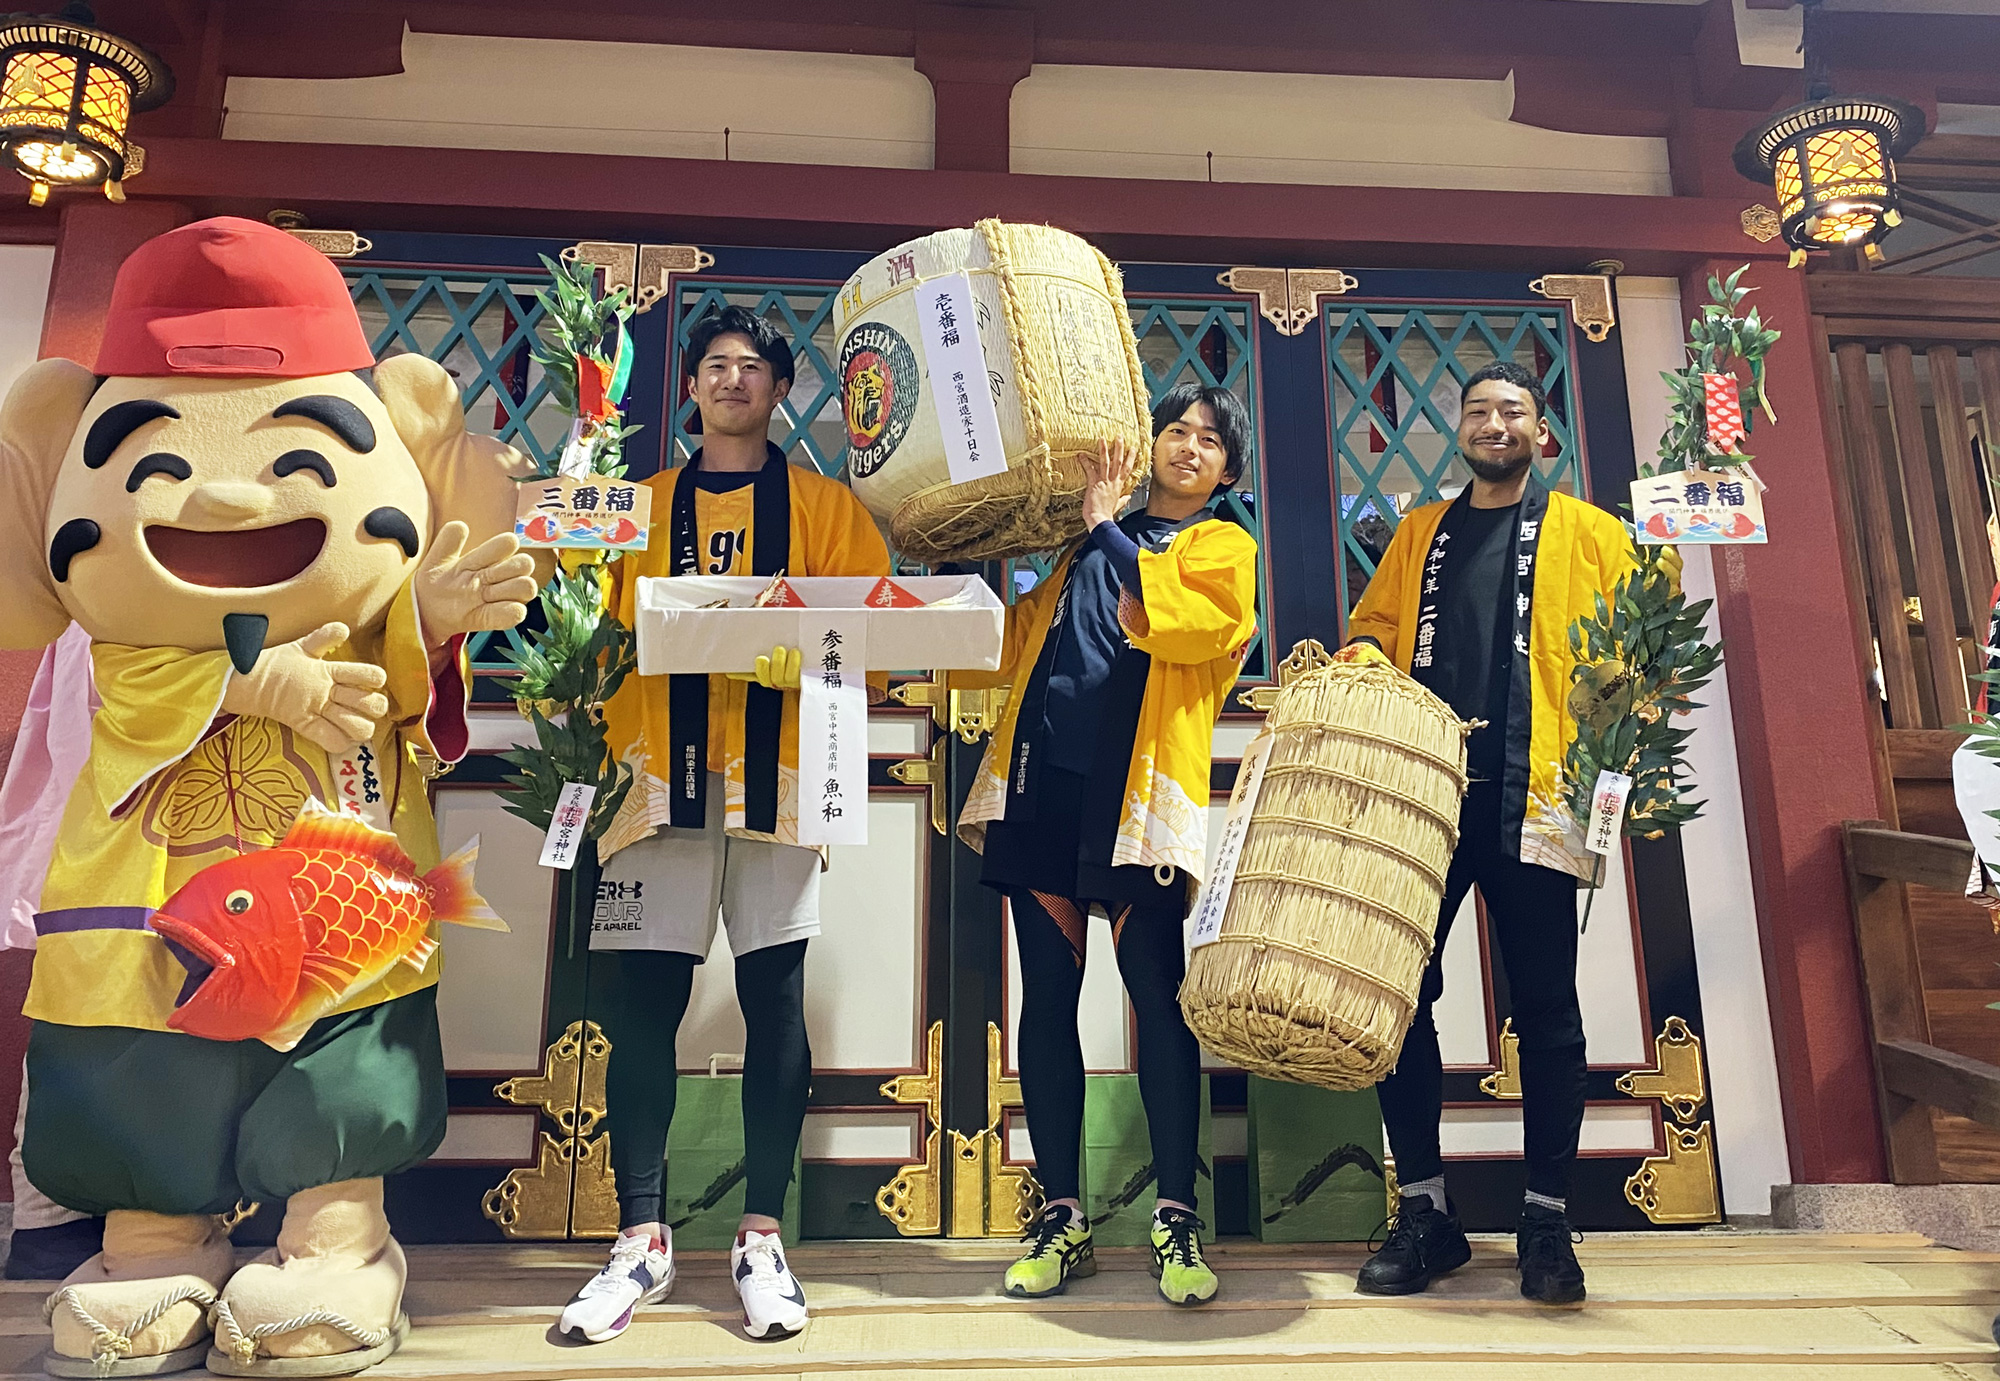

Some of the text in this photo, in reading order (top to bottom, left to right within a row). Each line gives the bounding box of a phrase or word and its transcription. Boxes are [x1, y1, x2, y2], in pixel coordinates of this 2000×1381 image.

[839, 330, 898, 392] ANSHIN
[935, 293, 980, 462] 壱番福 西宮酒造家十日会
[849, 419, 903, 474] Tigers
[536, 486, 635, 512] 三番福
[1650, 481, 1746, 507] 二番福
[875, 582, 898, 607] 寿
[1414, 532, 1451, 668] 令和七年 二番福
[821, 629, 843, 823] 参番福 西宮中央商店街 魚和
